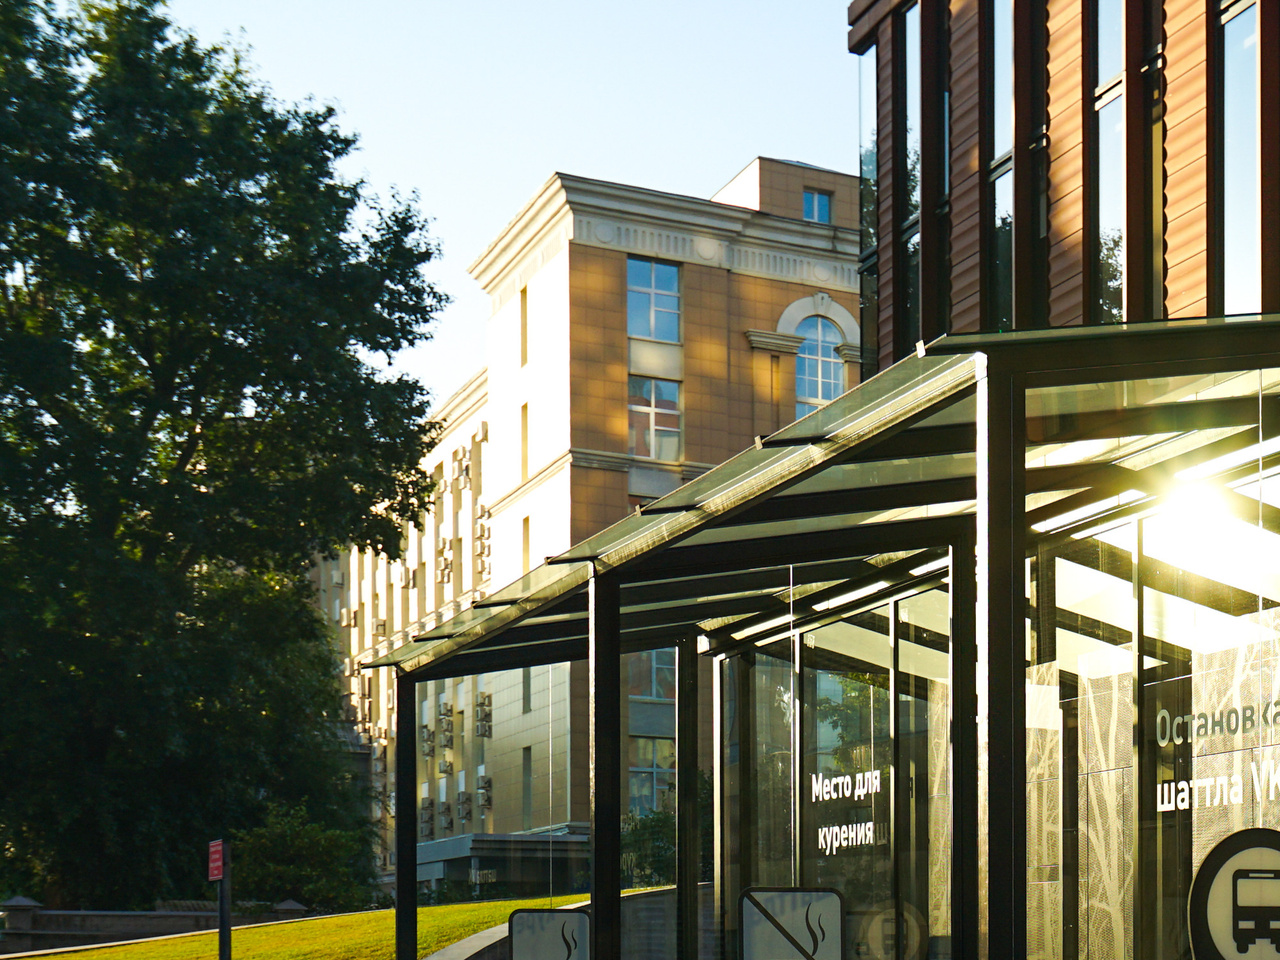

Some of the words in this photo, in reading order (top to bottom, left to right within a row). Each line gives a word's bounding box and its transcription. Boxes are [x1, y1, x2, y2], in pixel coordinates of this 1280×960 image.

[812, 773, 852, 802] Место
[854, 770, 880, 801] для
[1157, 773, 1244, 812] шаттла
[818, 821, 874, 856] курения
